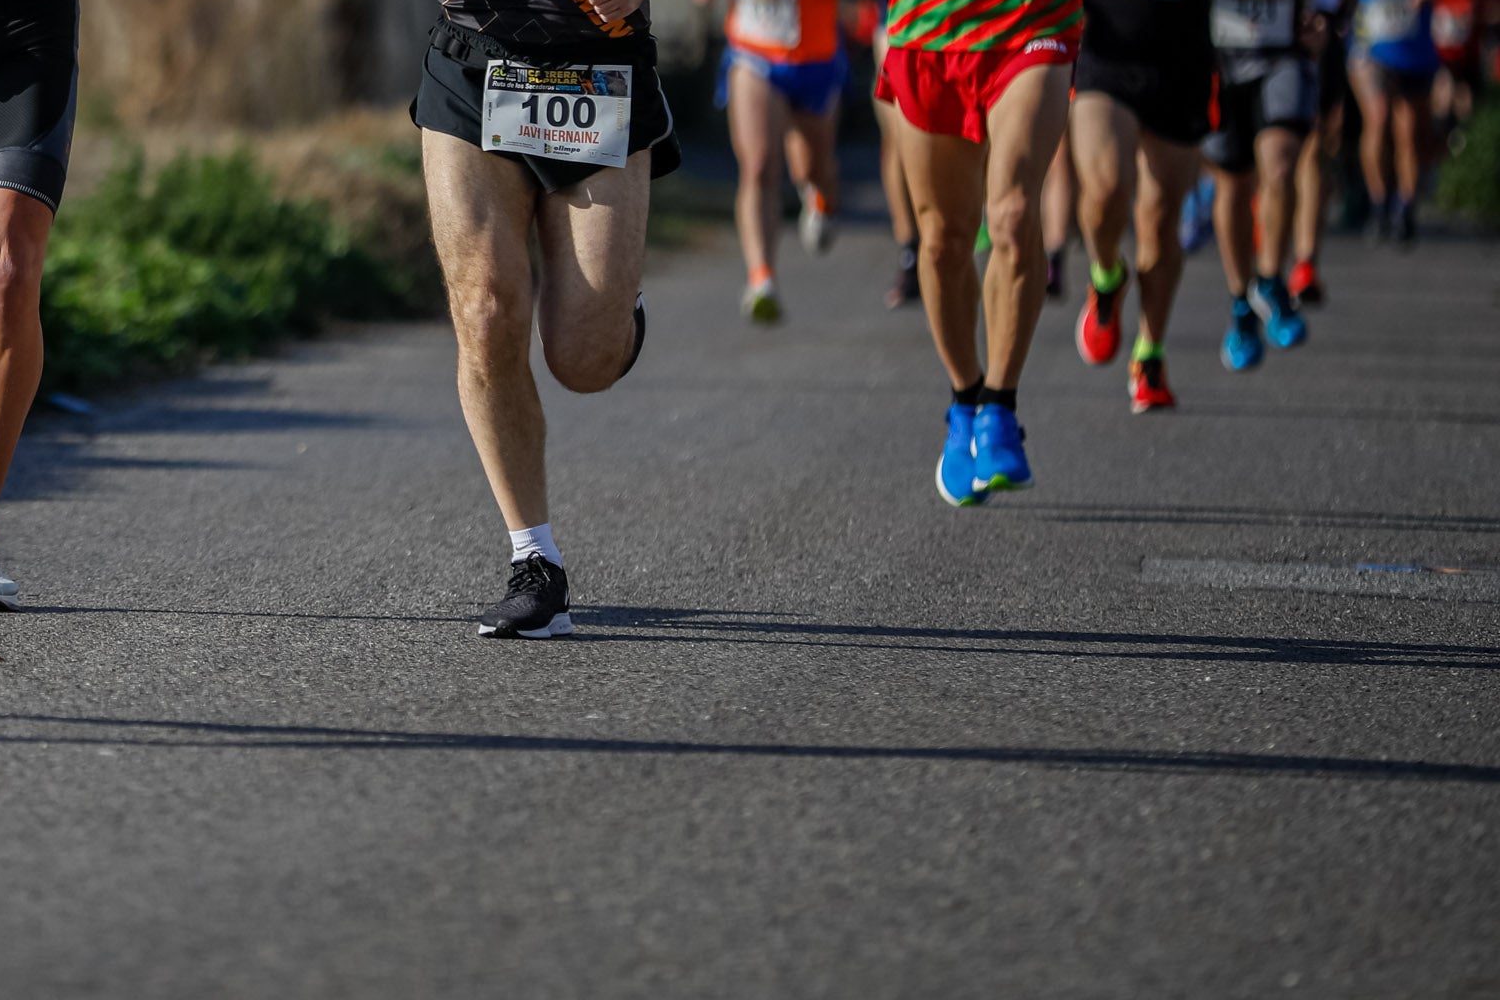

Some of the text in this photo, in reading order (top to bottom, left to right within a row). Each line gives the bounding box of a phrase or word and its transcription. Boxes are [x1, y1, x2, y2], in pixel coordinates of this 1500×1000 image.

[522, 94, 597, 129] 100
[518, 125, 541, 140] JAVI
[543, 130, 600, 145] HERNAINZ
[553, 145, 581, 153] olimpo
